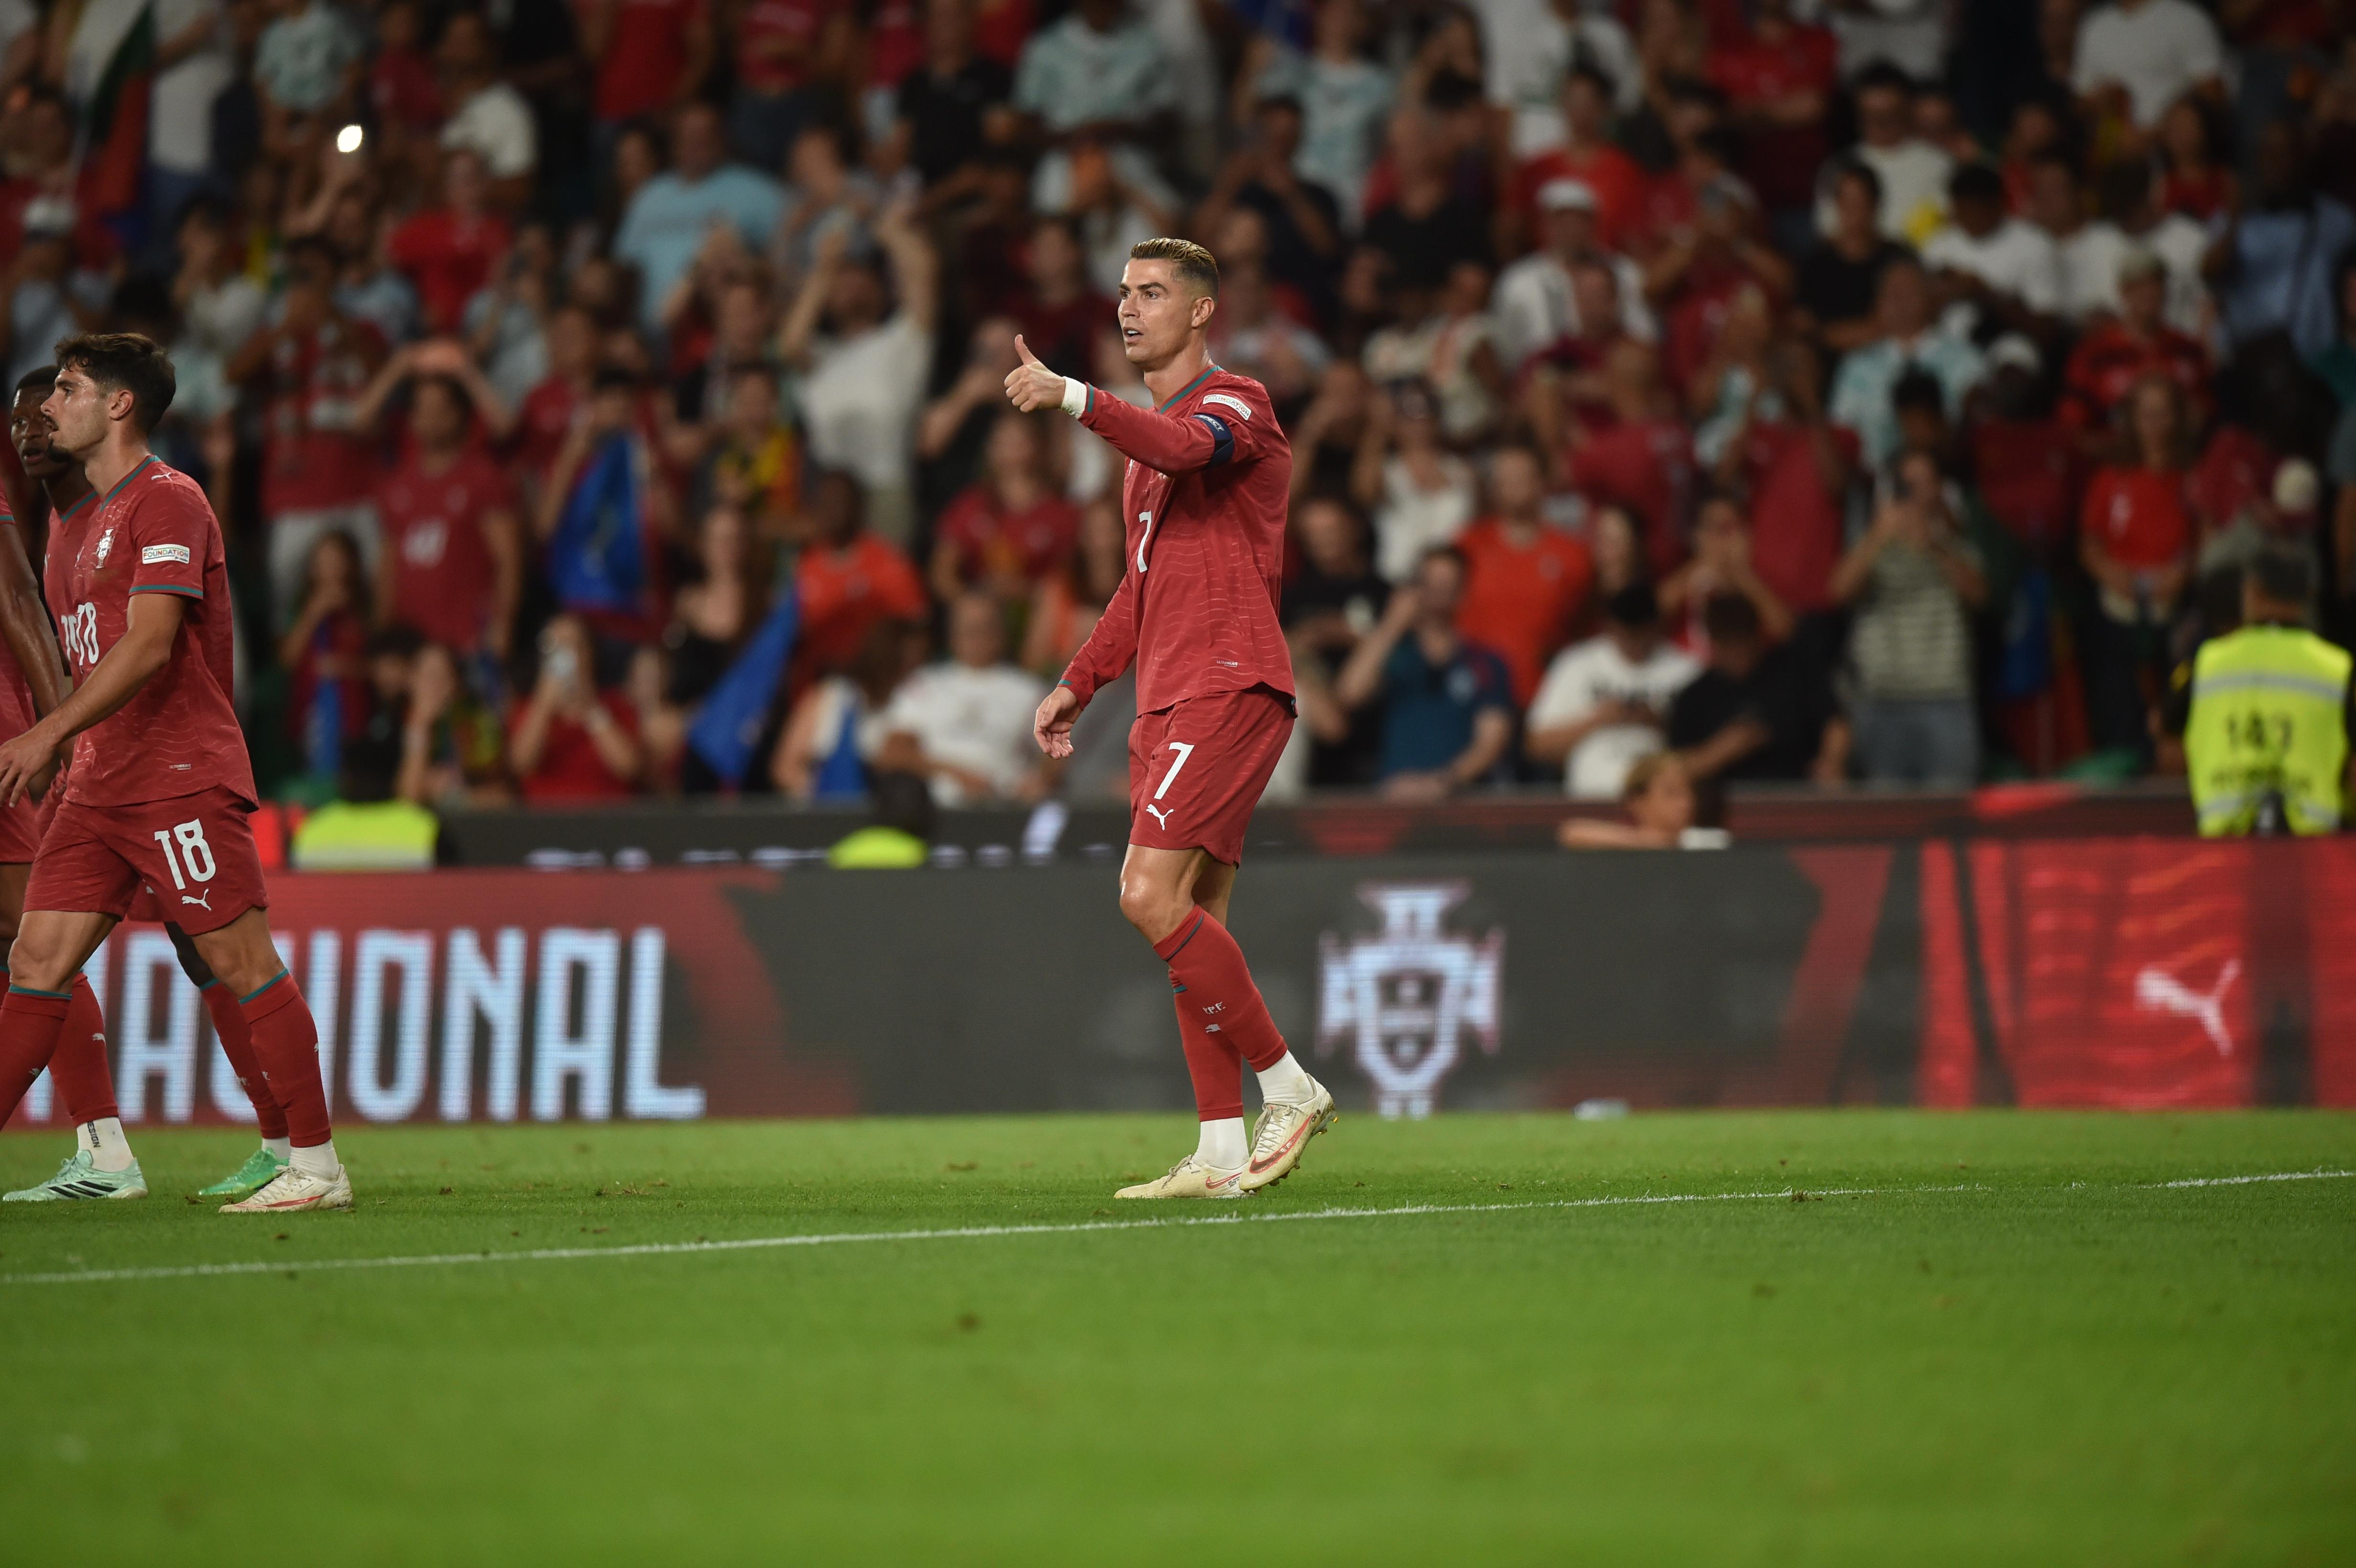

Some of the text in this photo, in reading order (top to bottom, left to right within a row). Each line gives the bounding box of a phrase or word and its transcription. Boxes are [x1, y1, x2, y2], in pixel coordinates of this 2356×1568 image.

[143, 549, 188, 558] FOUNDATION
[1137, 510, 1151, 573] 7
[76, 602, 99, 666] 18
[1154, 742, 1195, 800] 7
[154, 818, 216, 890] 18
